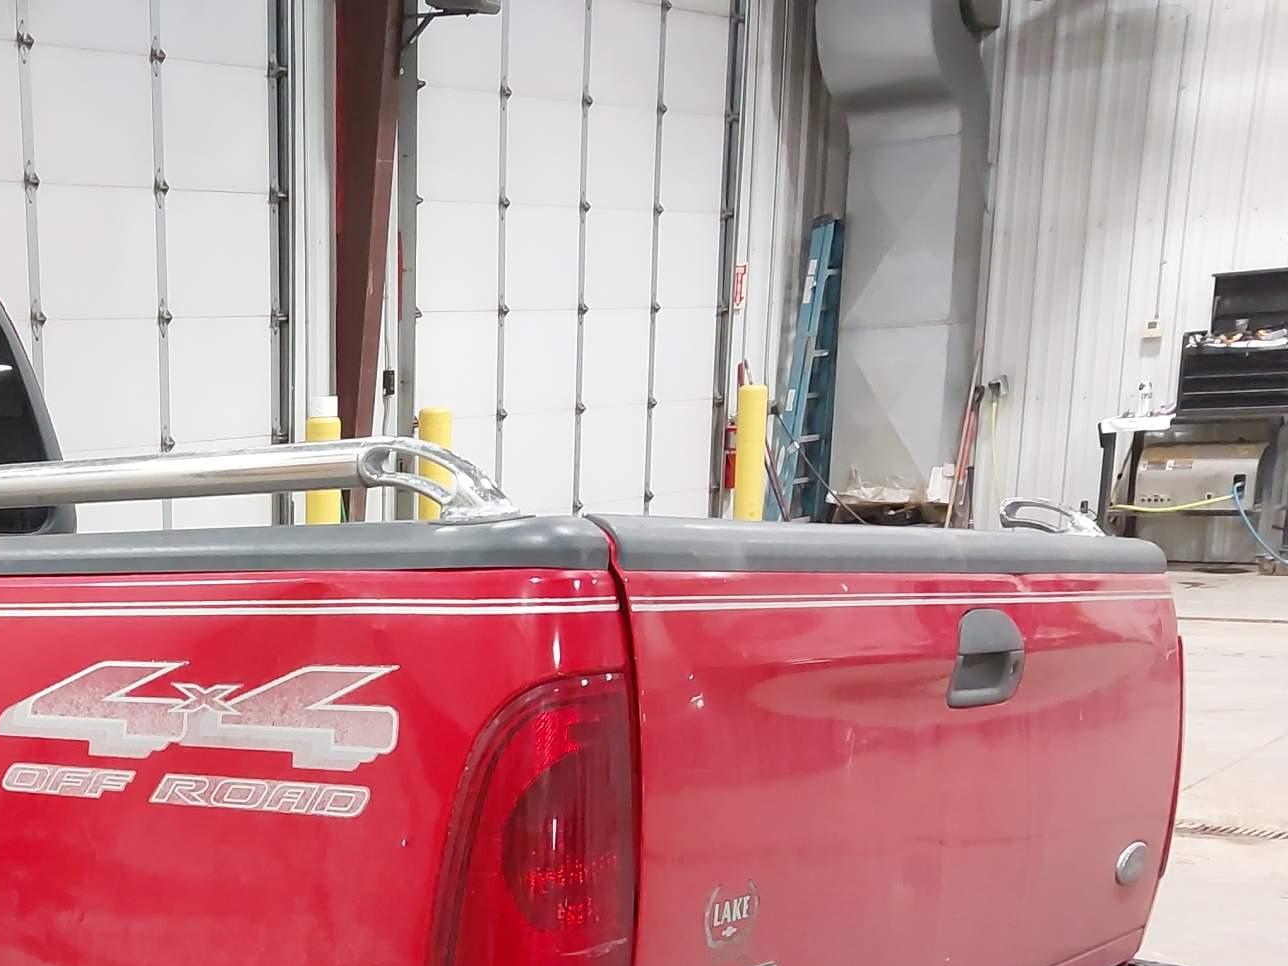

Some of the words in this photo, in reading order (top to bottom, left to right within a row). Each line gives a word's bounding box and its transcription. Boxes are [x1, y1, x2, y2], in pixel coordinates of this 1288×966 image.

[1, 762, 136, 799] OFF
[149, 773, 371, 818] ROAD
[713, 895, 751, 927] LAKE
